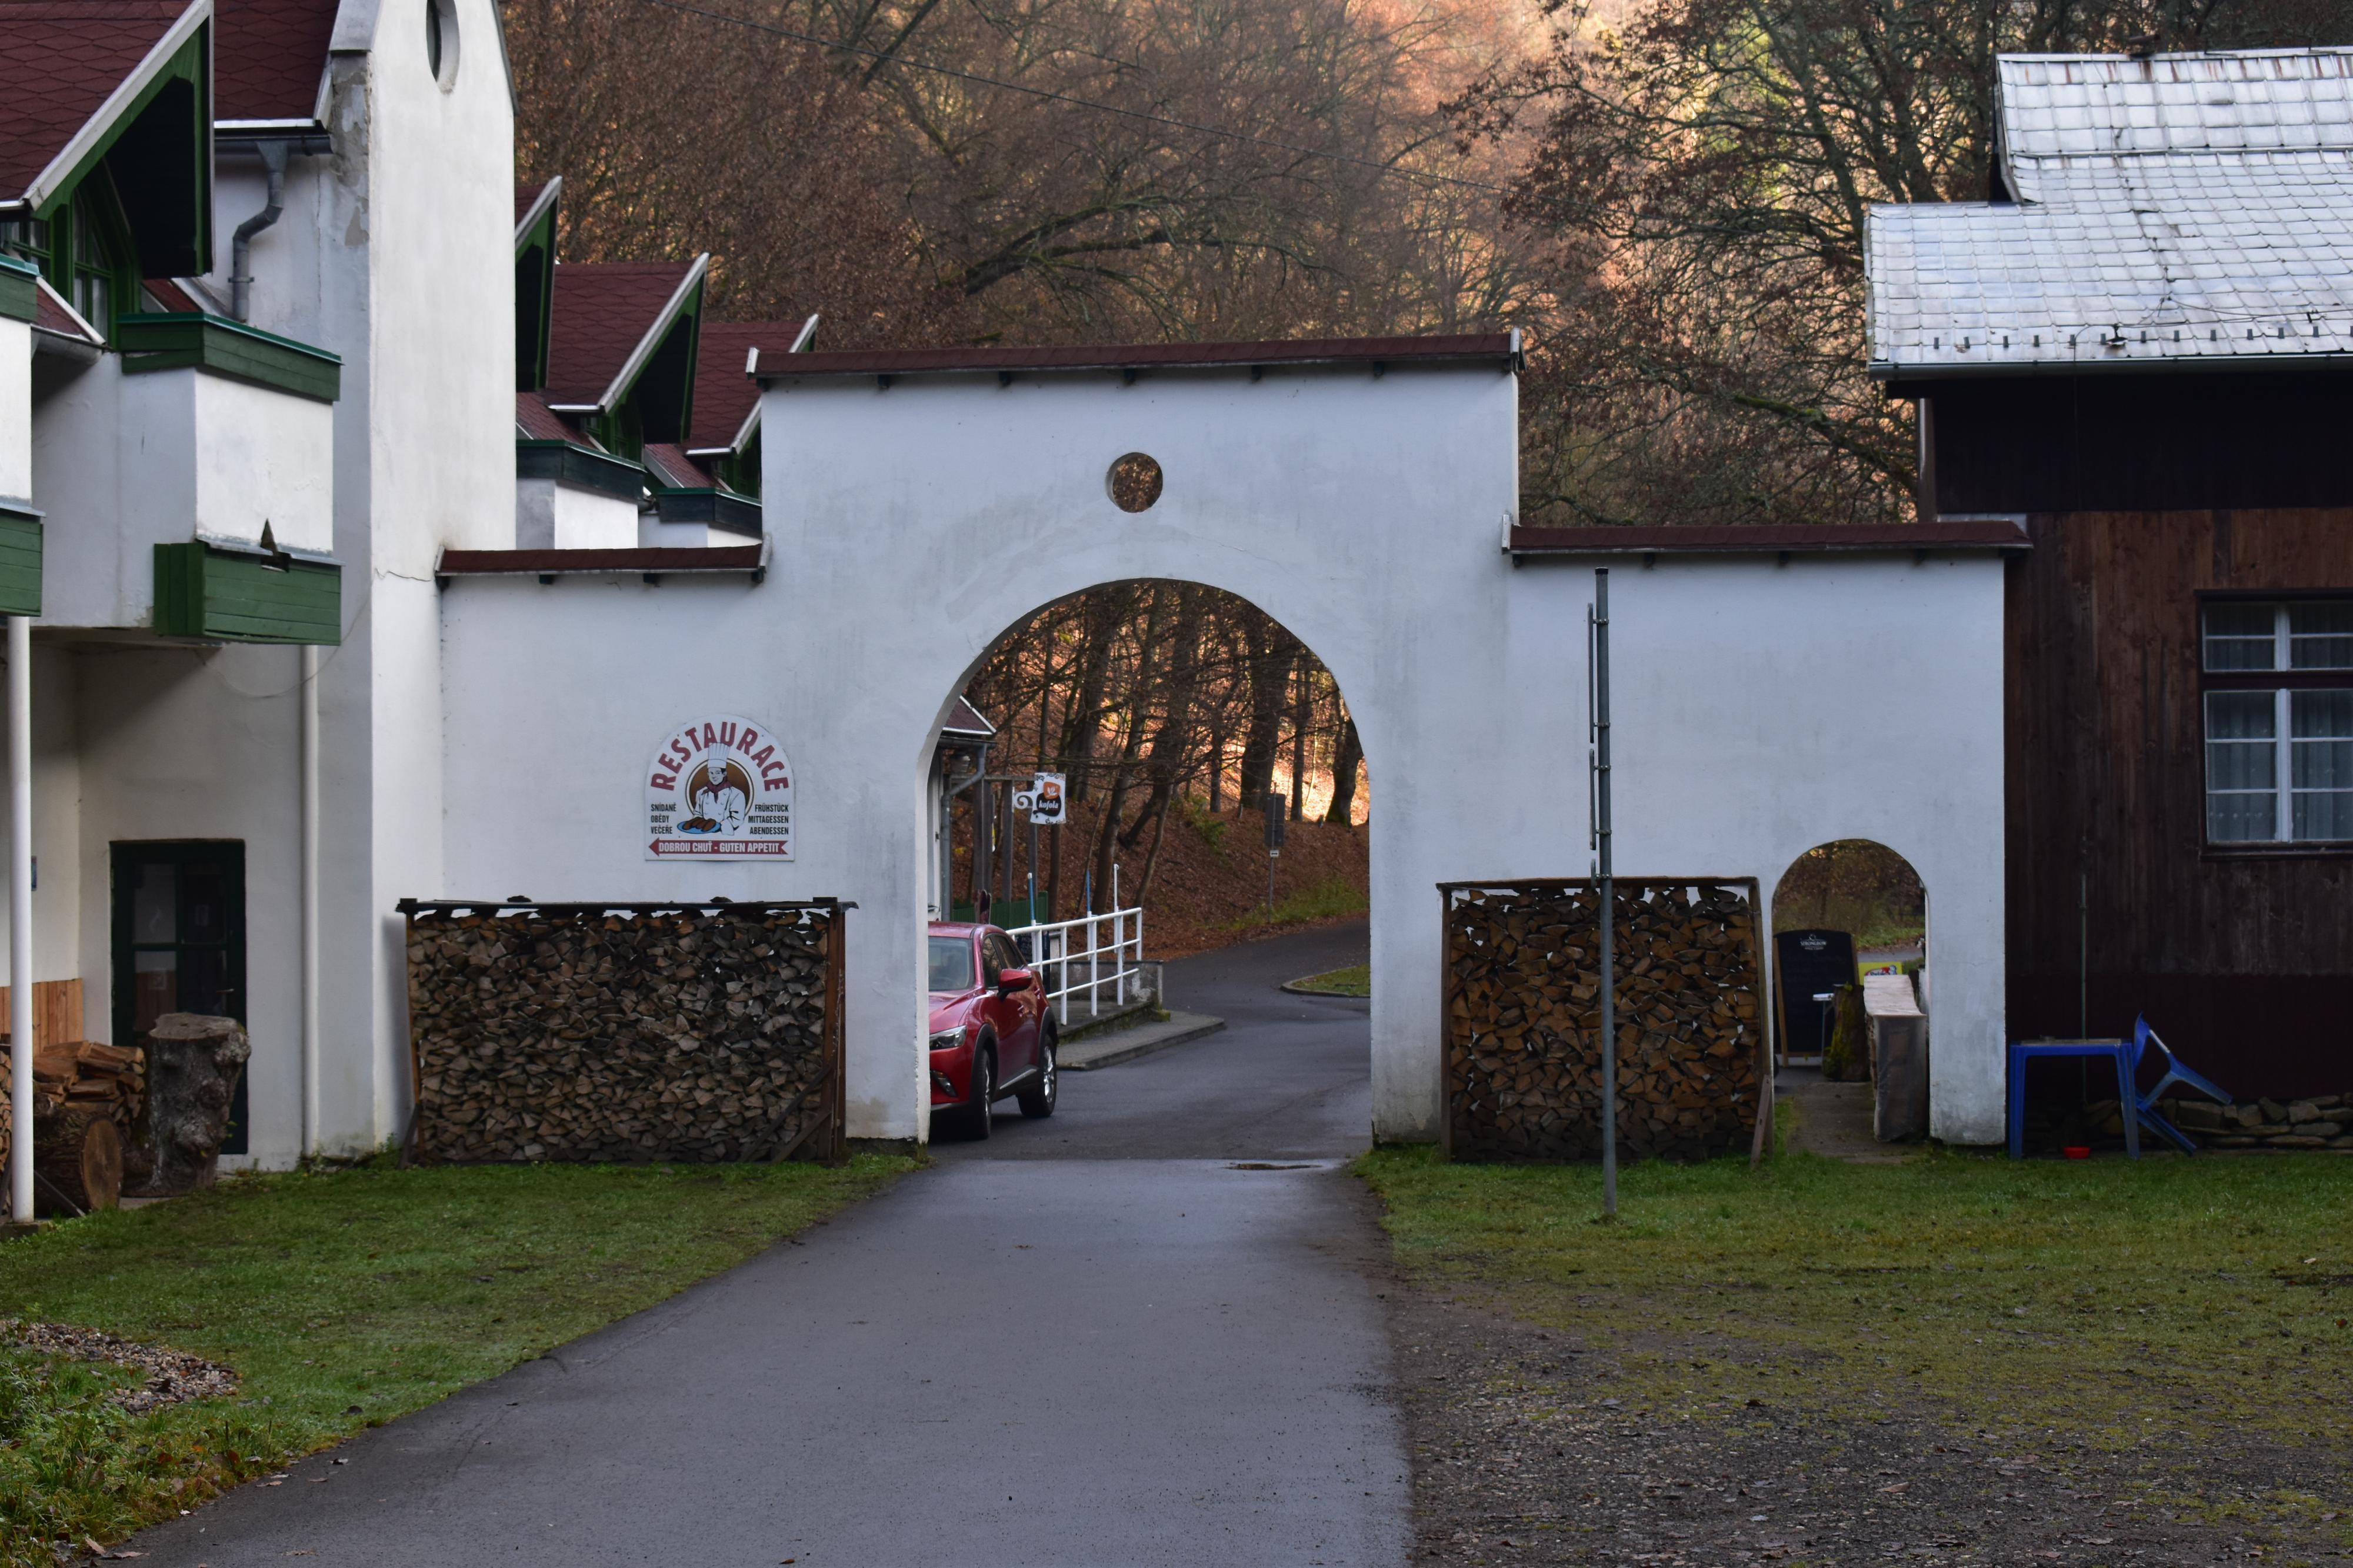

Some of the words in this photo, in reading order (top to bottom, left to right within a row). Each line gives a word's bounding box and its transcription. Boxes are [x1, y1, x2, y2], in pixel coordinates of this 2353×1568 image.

[651, 722, 789, 792] RESTAURACE
[651, 802, 676, 812] SNÍDANĚ
[755, 802, 789, 812] FRÜHSTÜCK
[1039, 800, 1059, 810] kofola
[651, 813, 669, 823] OBĚDY
[748, 815, 789, 823] MITTAGESSEN
[651, 825, 672, 834] VEČEŘE
[749, 826, 789, 835] ABENDESSEN
[659, 842, 691, 852] DOBROU
[692, 840, 712, 852] CHUŤ
[719, 842, 745, 852] GUTEN
[747, 843, 779, 853] APPETIT
